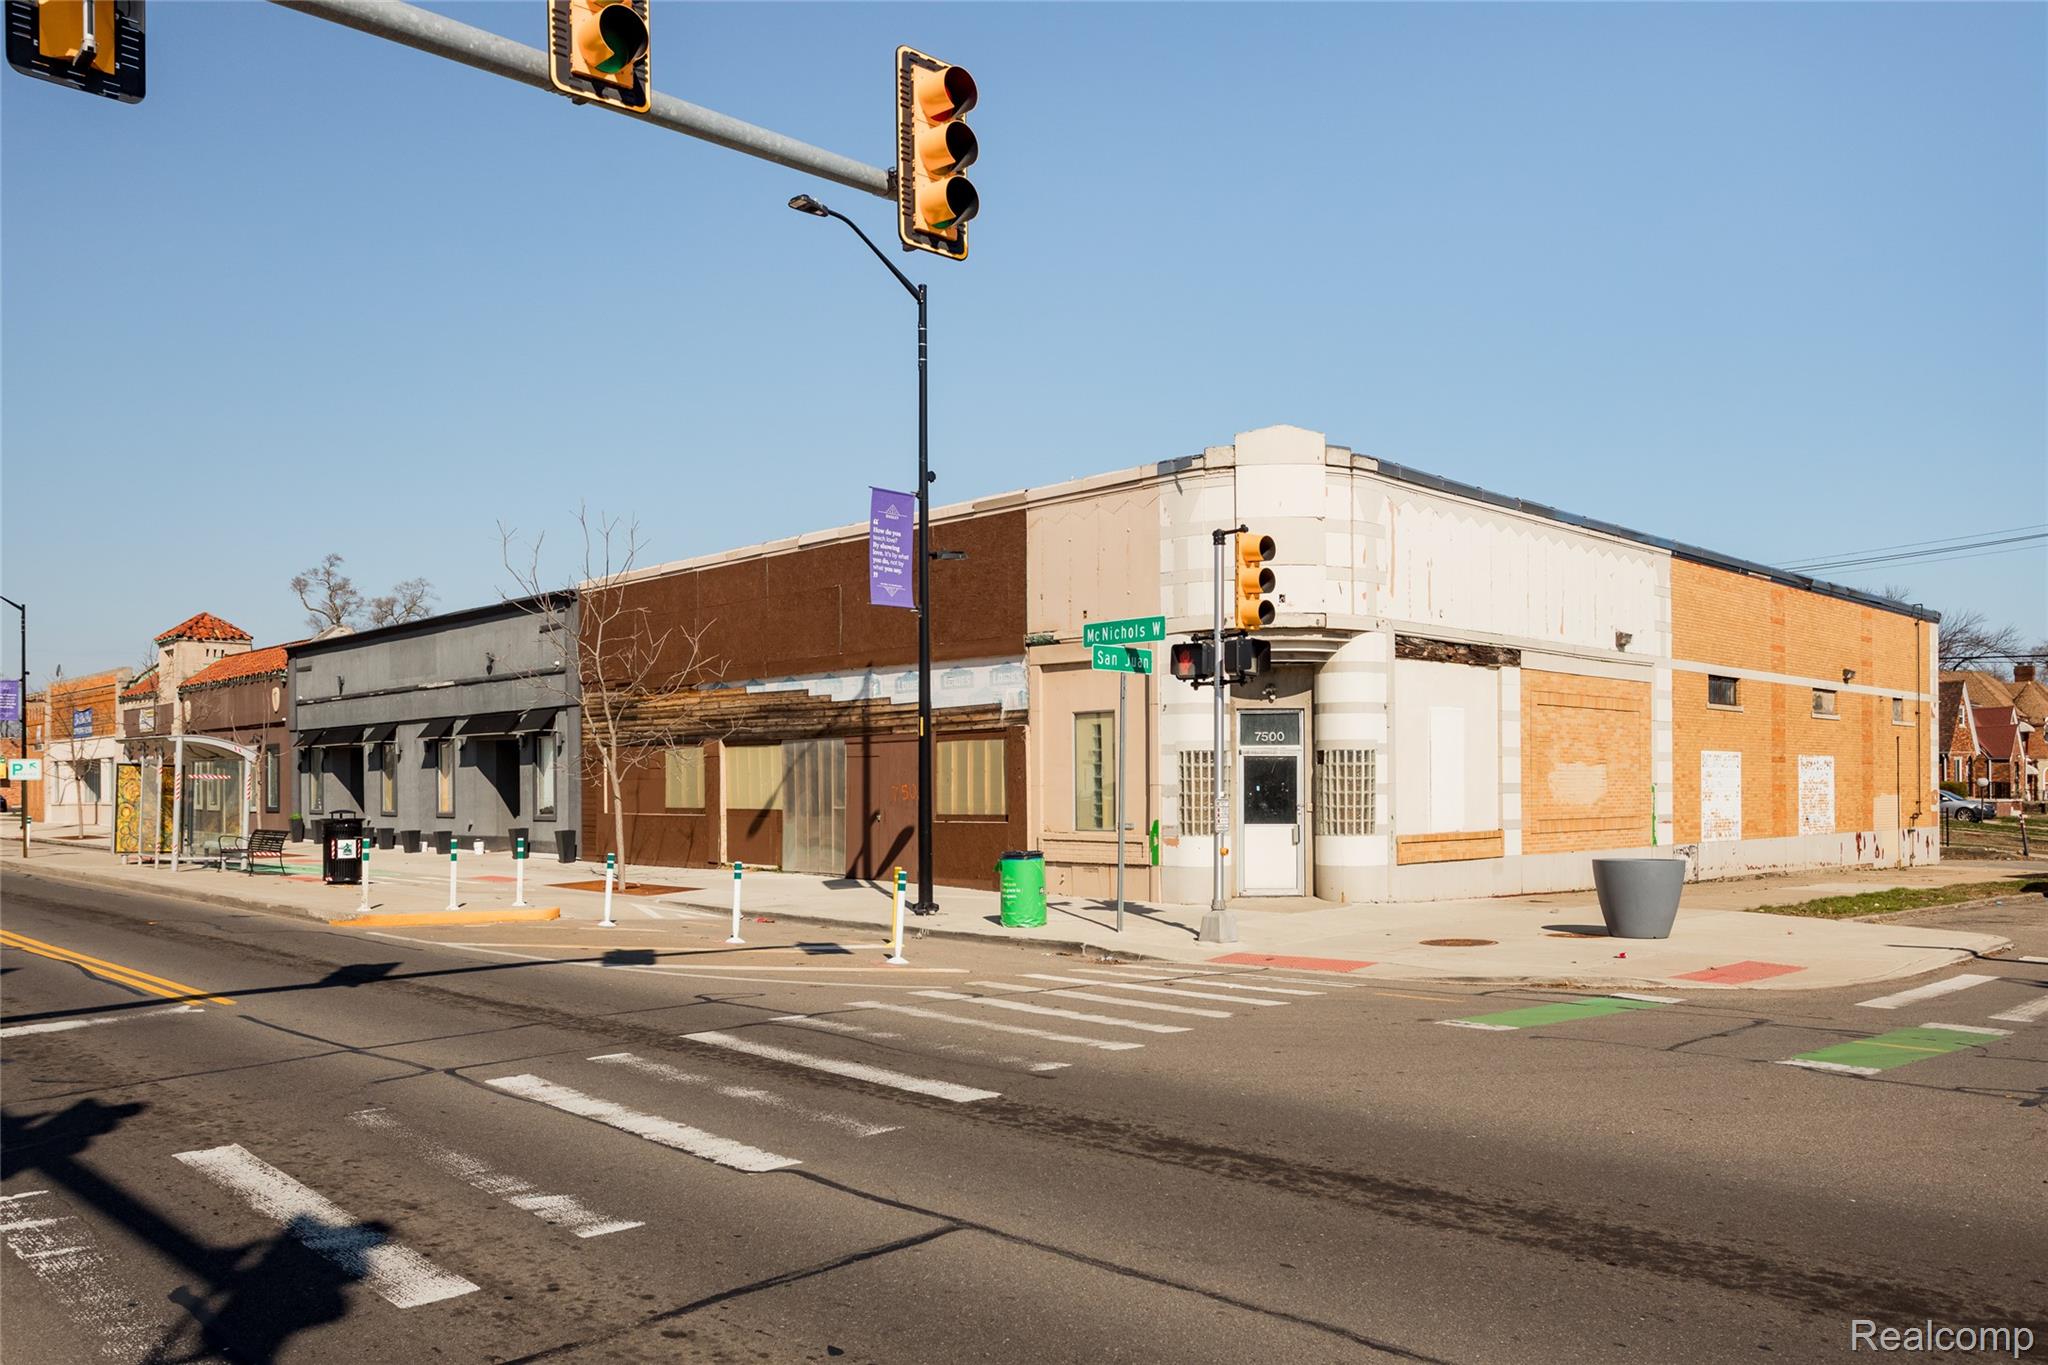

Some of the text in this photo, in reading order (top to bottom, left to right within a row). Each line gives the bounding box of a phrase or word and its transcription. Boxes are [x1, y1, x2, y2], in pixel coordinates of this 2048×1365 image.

[880, 543, 900, 553] showing
[1087, 622, 1160, 642] McNichols W
[1097, 650, 1148, 669] San Juan
[1254, 732, 1285, 742] 7500
[12, 764, 23, 776] P
